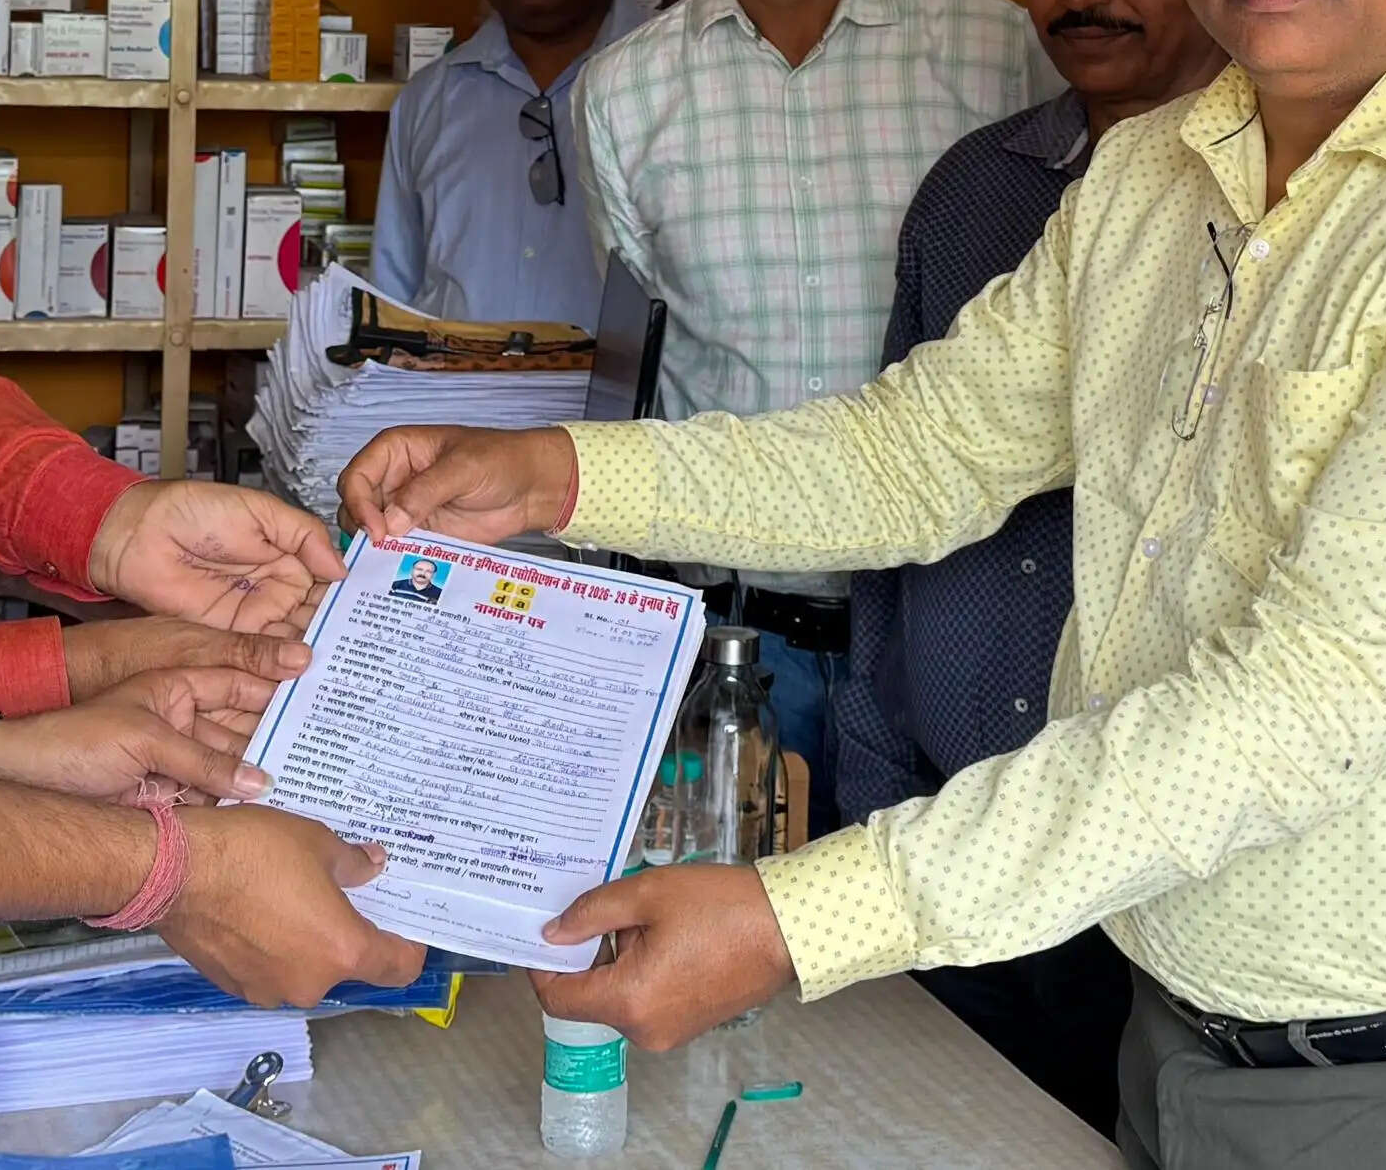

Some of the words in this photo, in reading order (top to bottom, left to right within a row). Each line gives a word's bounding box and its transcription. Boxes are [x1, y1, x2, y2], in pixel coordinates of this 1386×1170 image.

[510, 566, 561, 589] एसोसिएशन
[561, 576, 572, 590] के
[628, 590, 639, 605] के
[638, 596, 664, 612] चुनाव
[474, 603, 524, 624] नामांकन
[528, 617, 546, 629] पत्र
